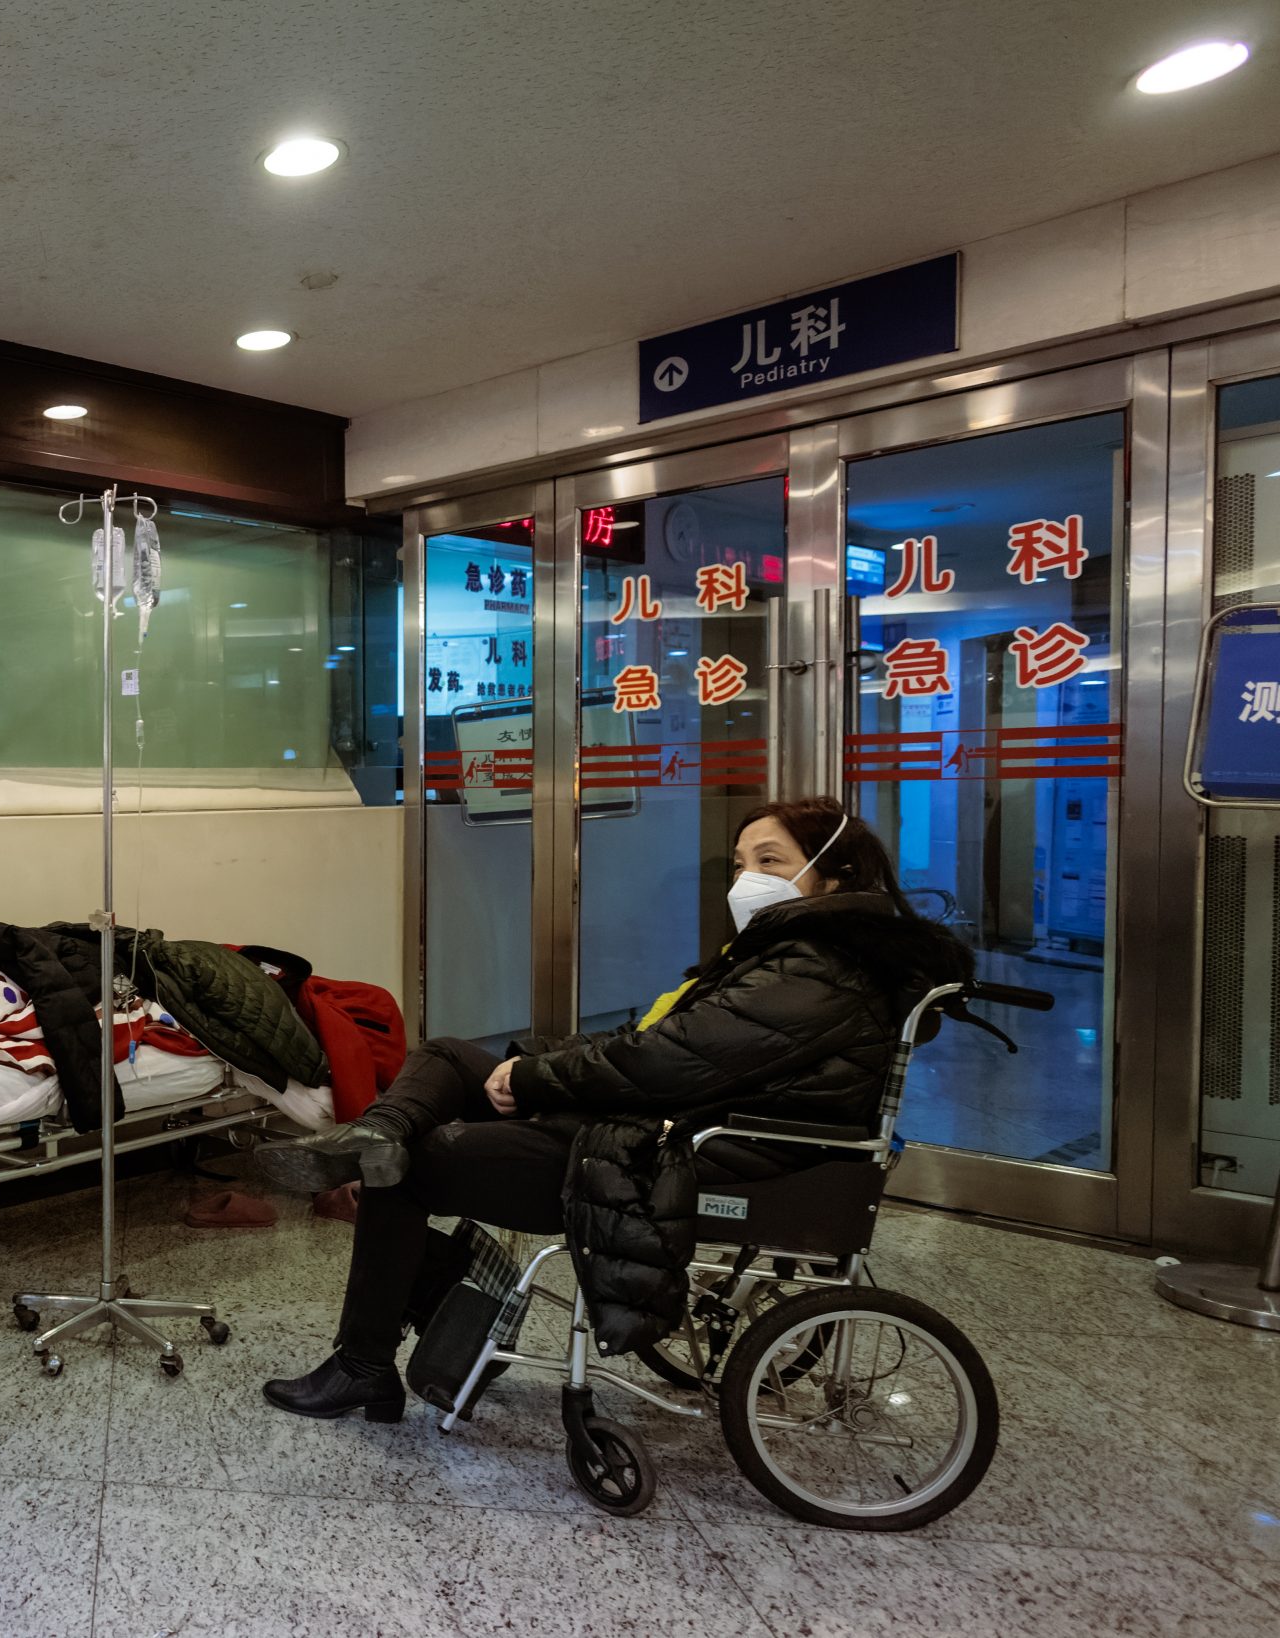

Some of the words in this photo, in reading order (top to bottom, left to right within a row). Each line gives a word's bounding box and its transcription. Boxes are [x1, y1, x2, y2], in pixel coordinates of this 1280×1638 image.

[730, 297, 846, 374] 儿科
[740, 356, 831, 389] Pediatry
[585, 506, 614, 546] 房
[465, 561, 527, 599] 急诊药
[884, 514, 1089, 600] 儿科
[612, 561, 749, 625] 儿科
[485, 637, 527, 668] 儿科
[882, 622, 1090, 700] 急诊
[428, 666, 460, 693] 发药
[612, 654, 747, 714] 急诊
